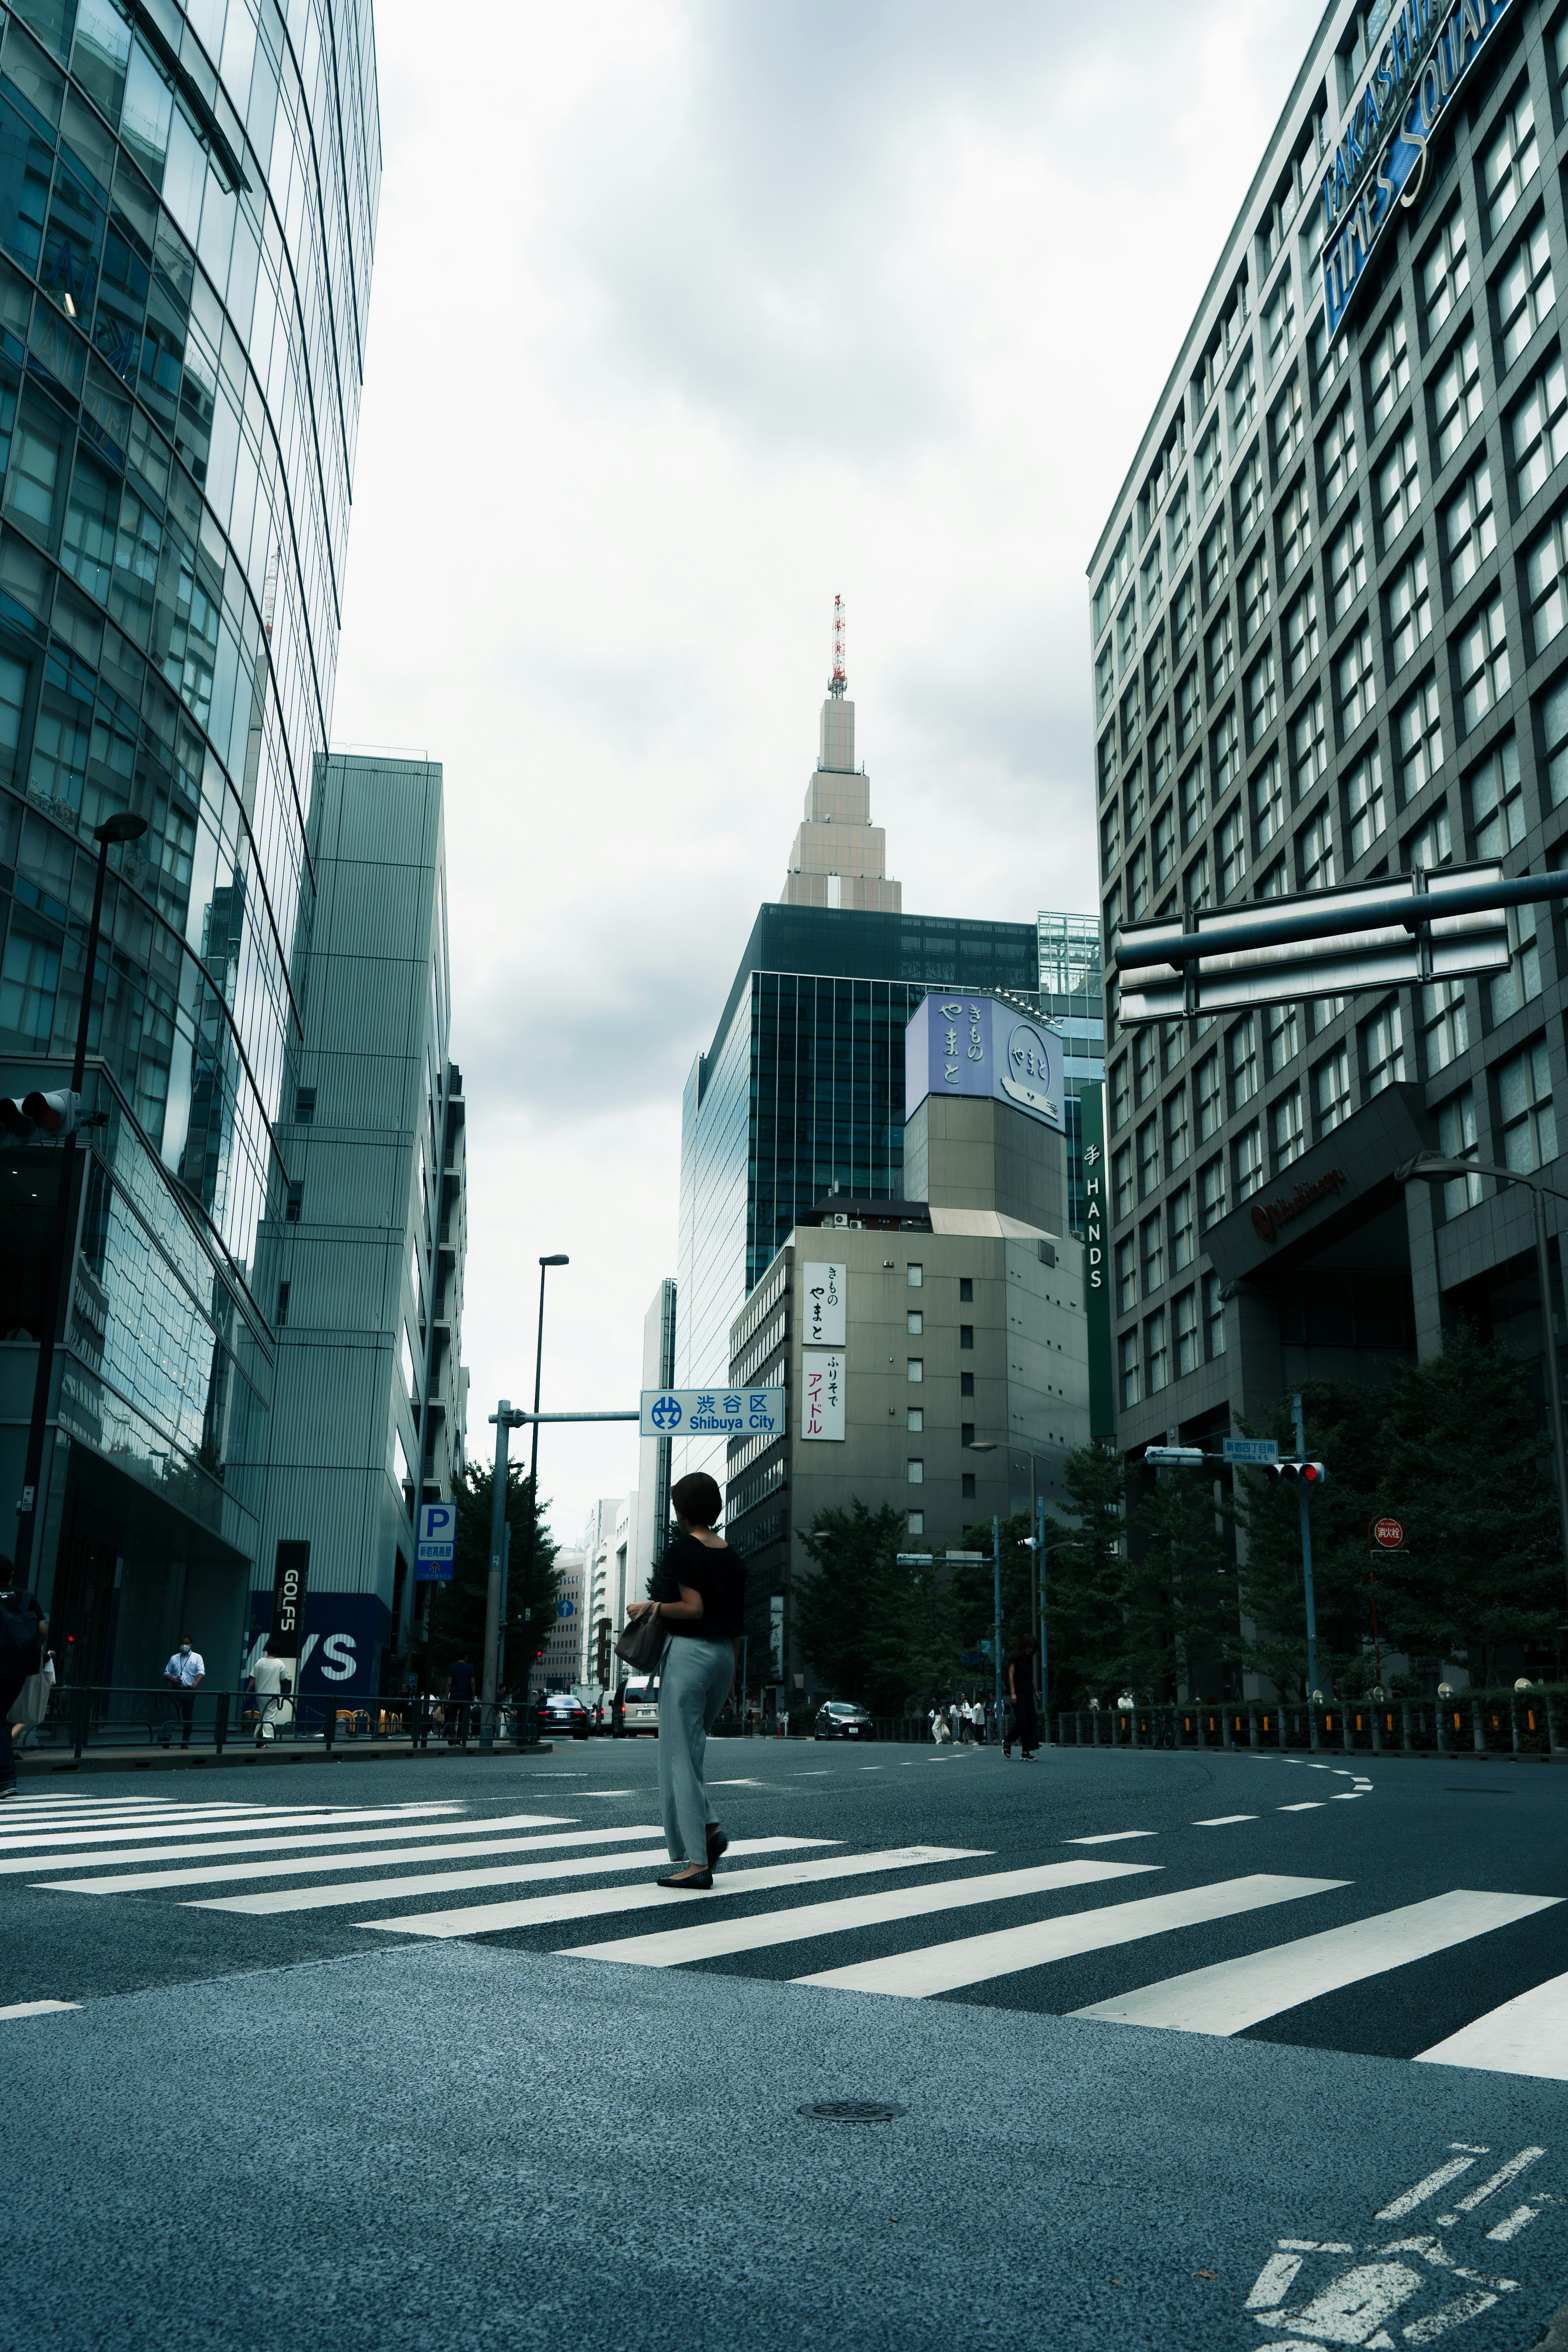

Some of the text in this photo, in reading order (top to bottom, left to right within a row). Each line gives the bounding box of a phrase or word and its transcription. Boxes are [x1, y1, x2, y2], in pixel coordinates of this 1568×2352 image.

[1326, 148, 1394, 310] TIMES
[938, 1002, 962, 1083] やまと
[967, 1003, 983, 1061] きもの
[1013, 1047, 1046, 1079] やまと
[1265, 1167, 1343, 1227] Takashimaya
[1087, 1178, 1102, 1287] HANDS
[827, 1266, 838, 1306] きもの
[809, 1287, 824, 1340] やまと
[697, 1395, 768, 1414] 渋谷区
[807, 1374, 822, 1434] アイドル
[828, 1356, 839, 1407] ふりそで
[690, 1414, 775, 1431] Shibuya City
[1226, 1441, 1275, 1454] 新宿四丁目南
[427, 1509, 449, 1537] P
[1377, 1527, 1400, 1539] 消火栓
[281, 1569, 298, 1631] GOLF5
